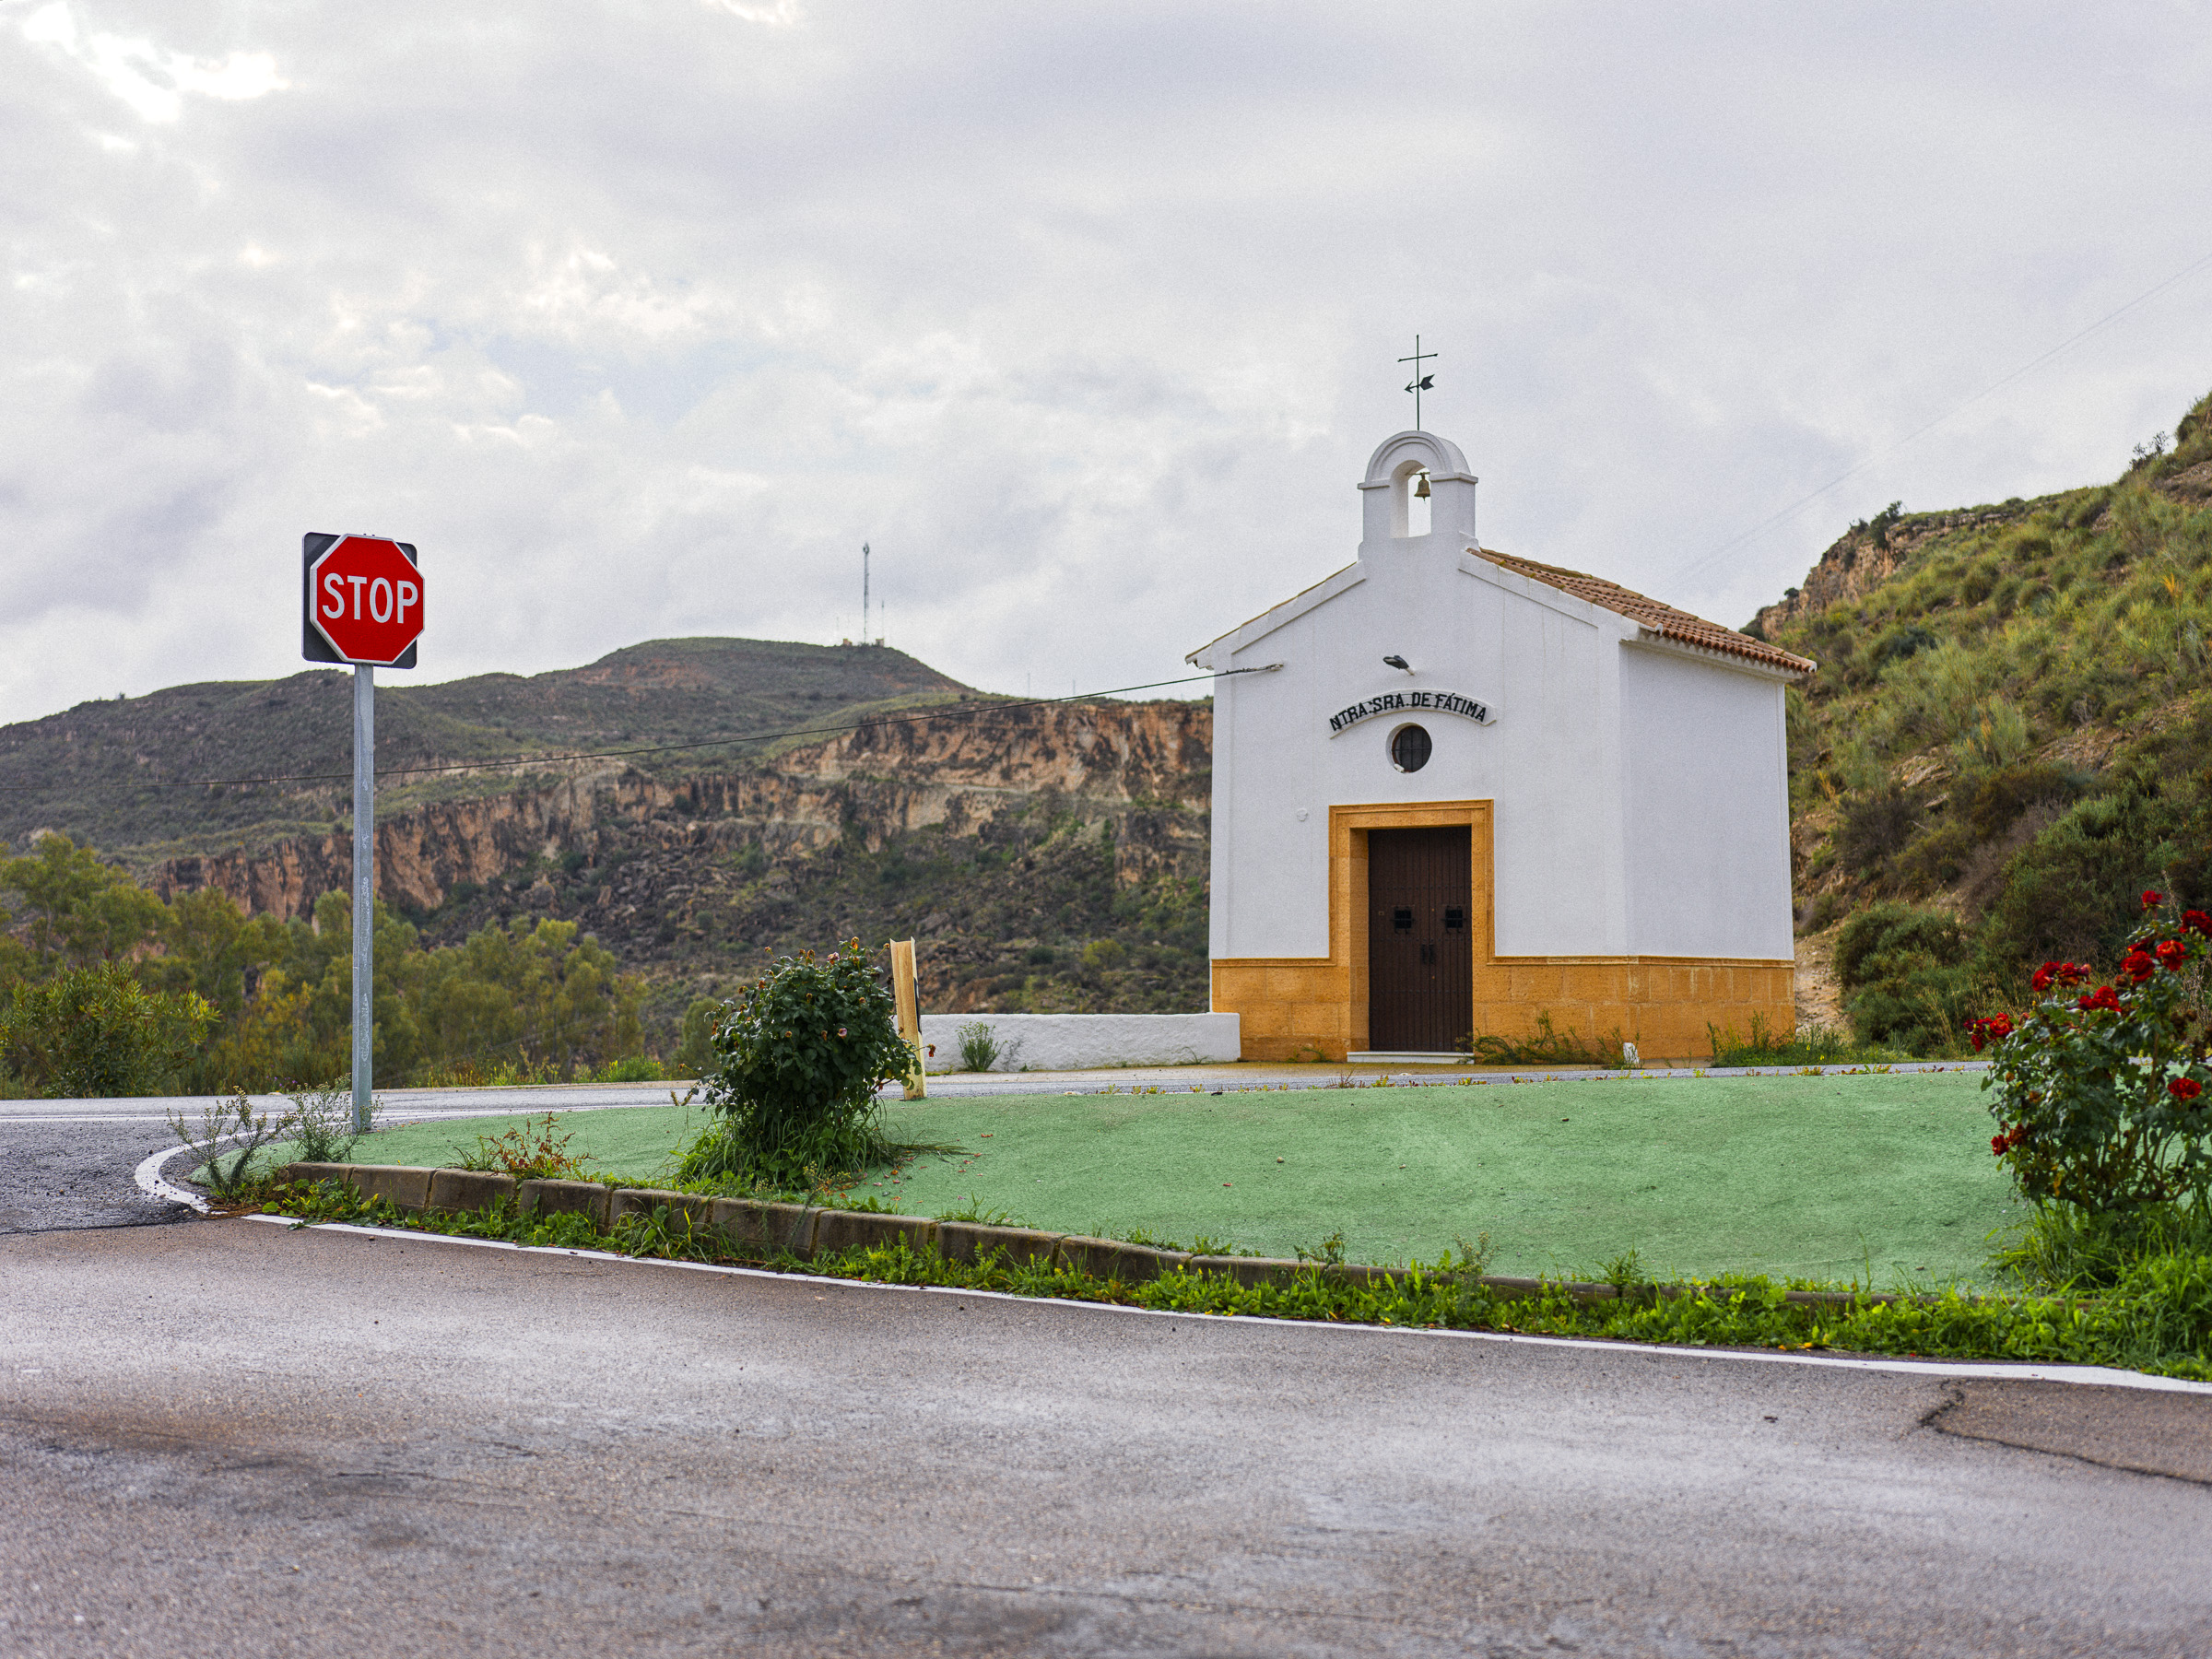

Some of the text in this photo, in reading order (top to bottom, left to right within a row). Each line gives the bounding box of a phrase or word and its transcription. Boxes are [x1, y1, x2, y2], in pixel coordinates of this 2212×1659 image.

[322, 572, 418, 624] STOP
[1411, 691, 1431, 707] DE
[1435, 692, 1487, 723] FÁTIMA
